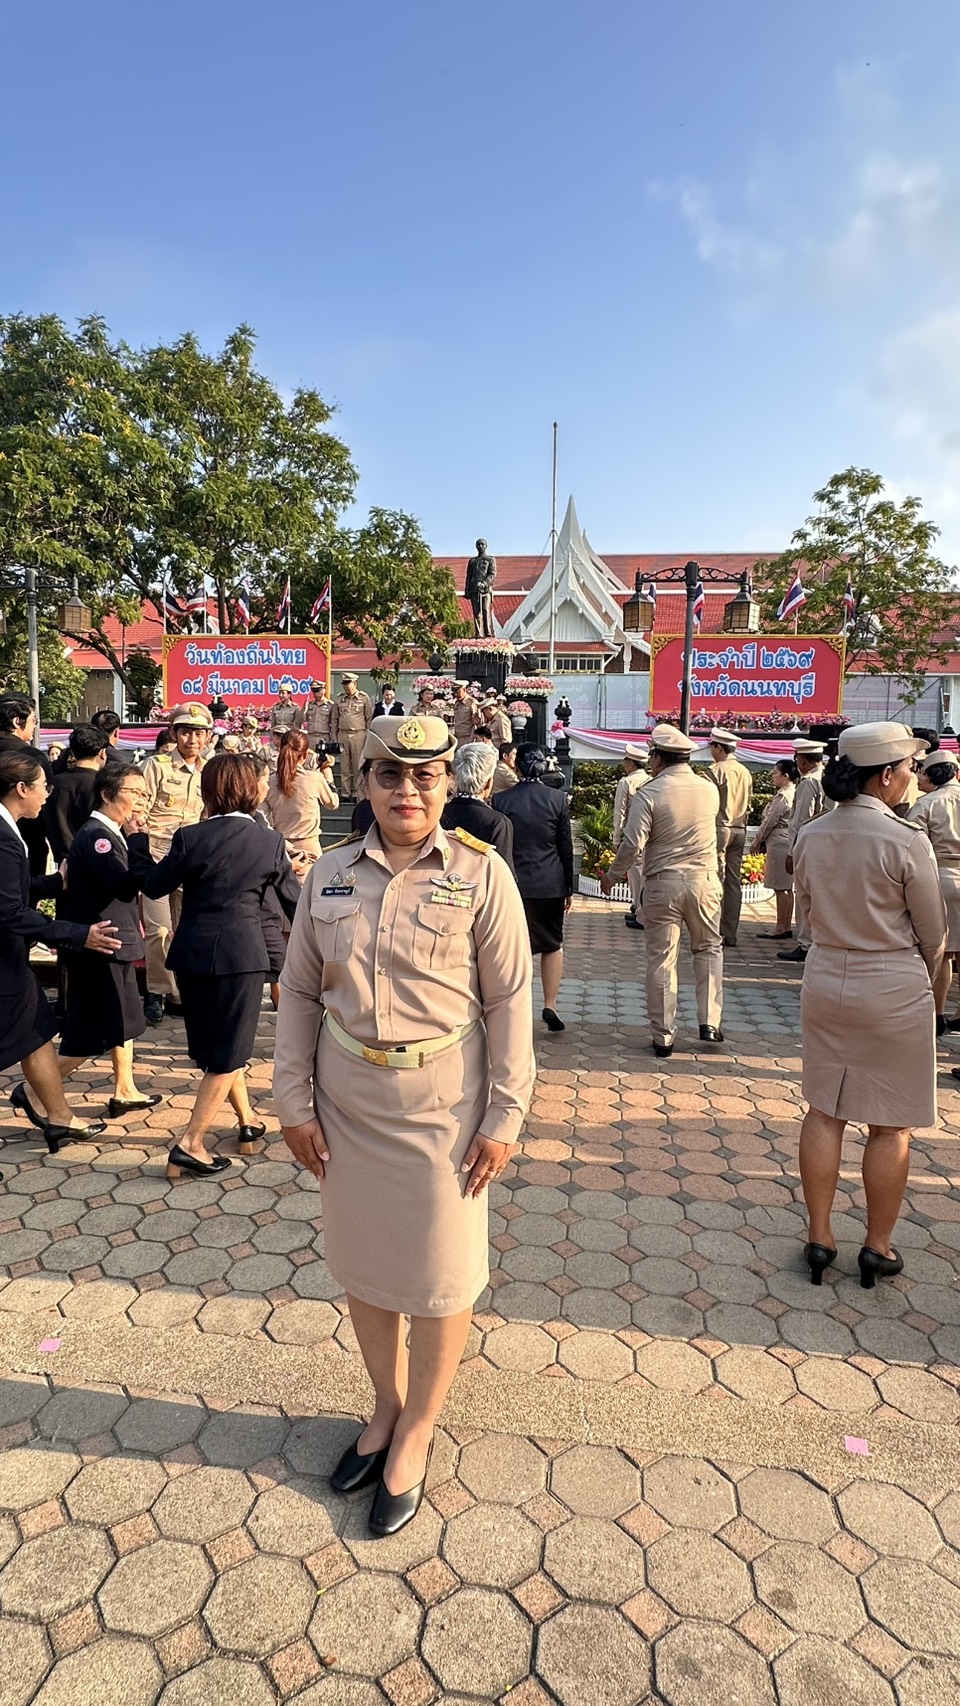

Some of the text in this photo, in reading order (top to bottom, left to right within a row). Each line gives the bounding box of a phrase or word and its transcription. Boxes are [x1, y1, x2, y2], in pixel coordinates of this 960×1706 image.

[185, 641, 307, 665] วันท้องถิ่นไทย
[760, 646, 815, 669] ๒๕๖๙
[182, 675, 203, 694] ๑๘
[207, 671, 264, 695] มีนาคม
